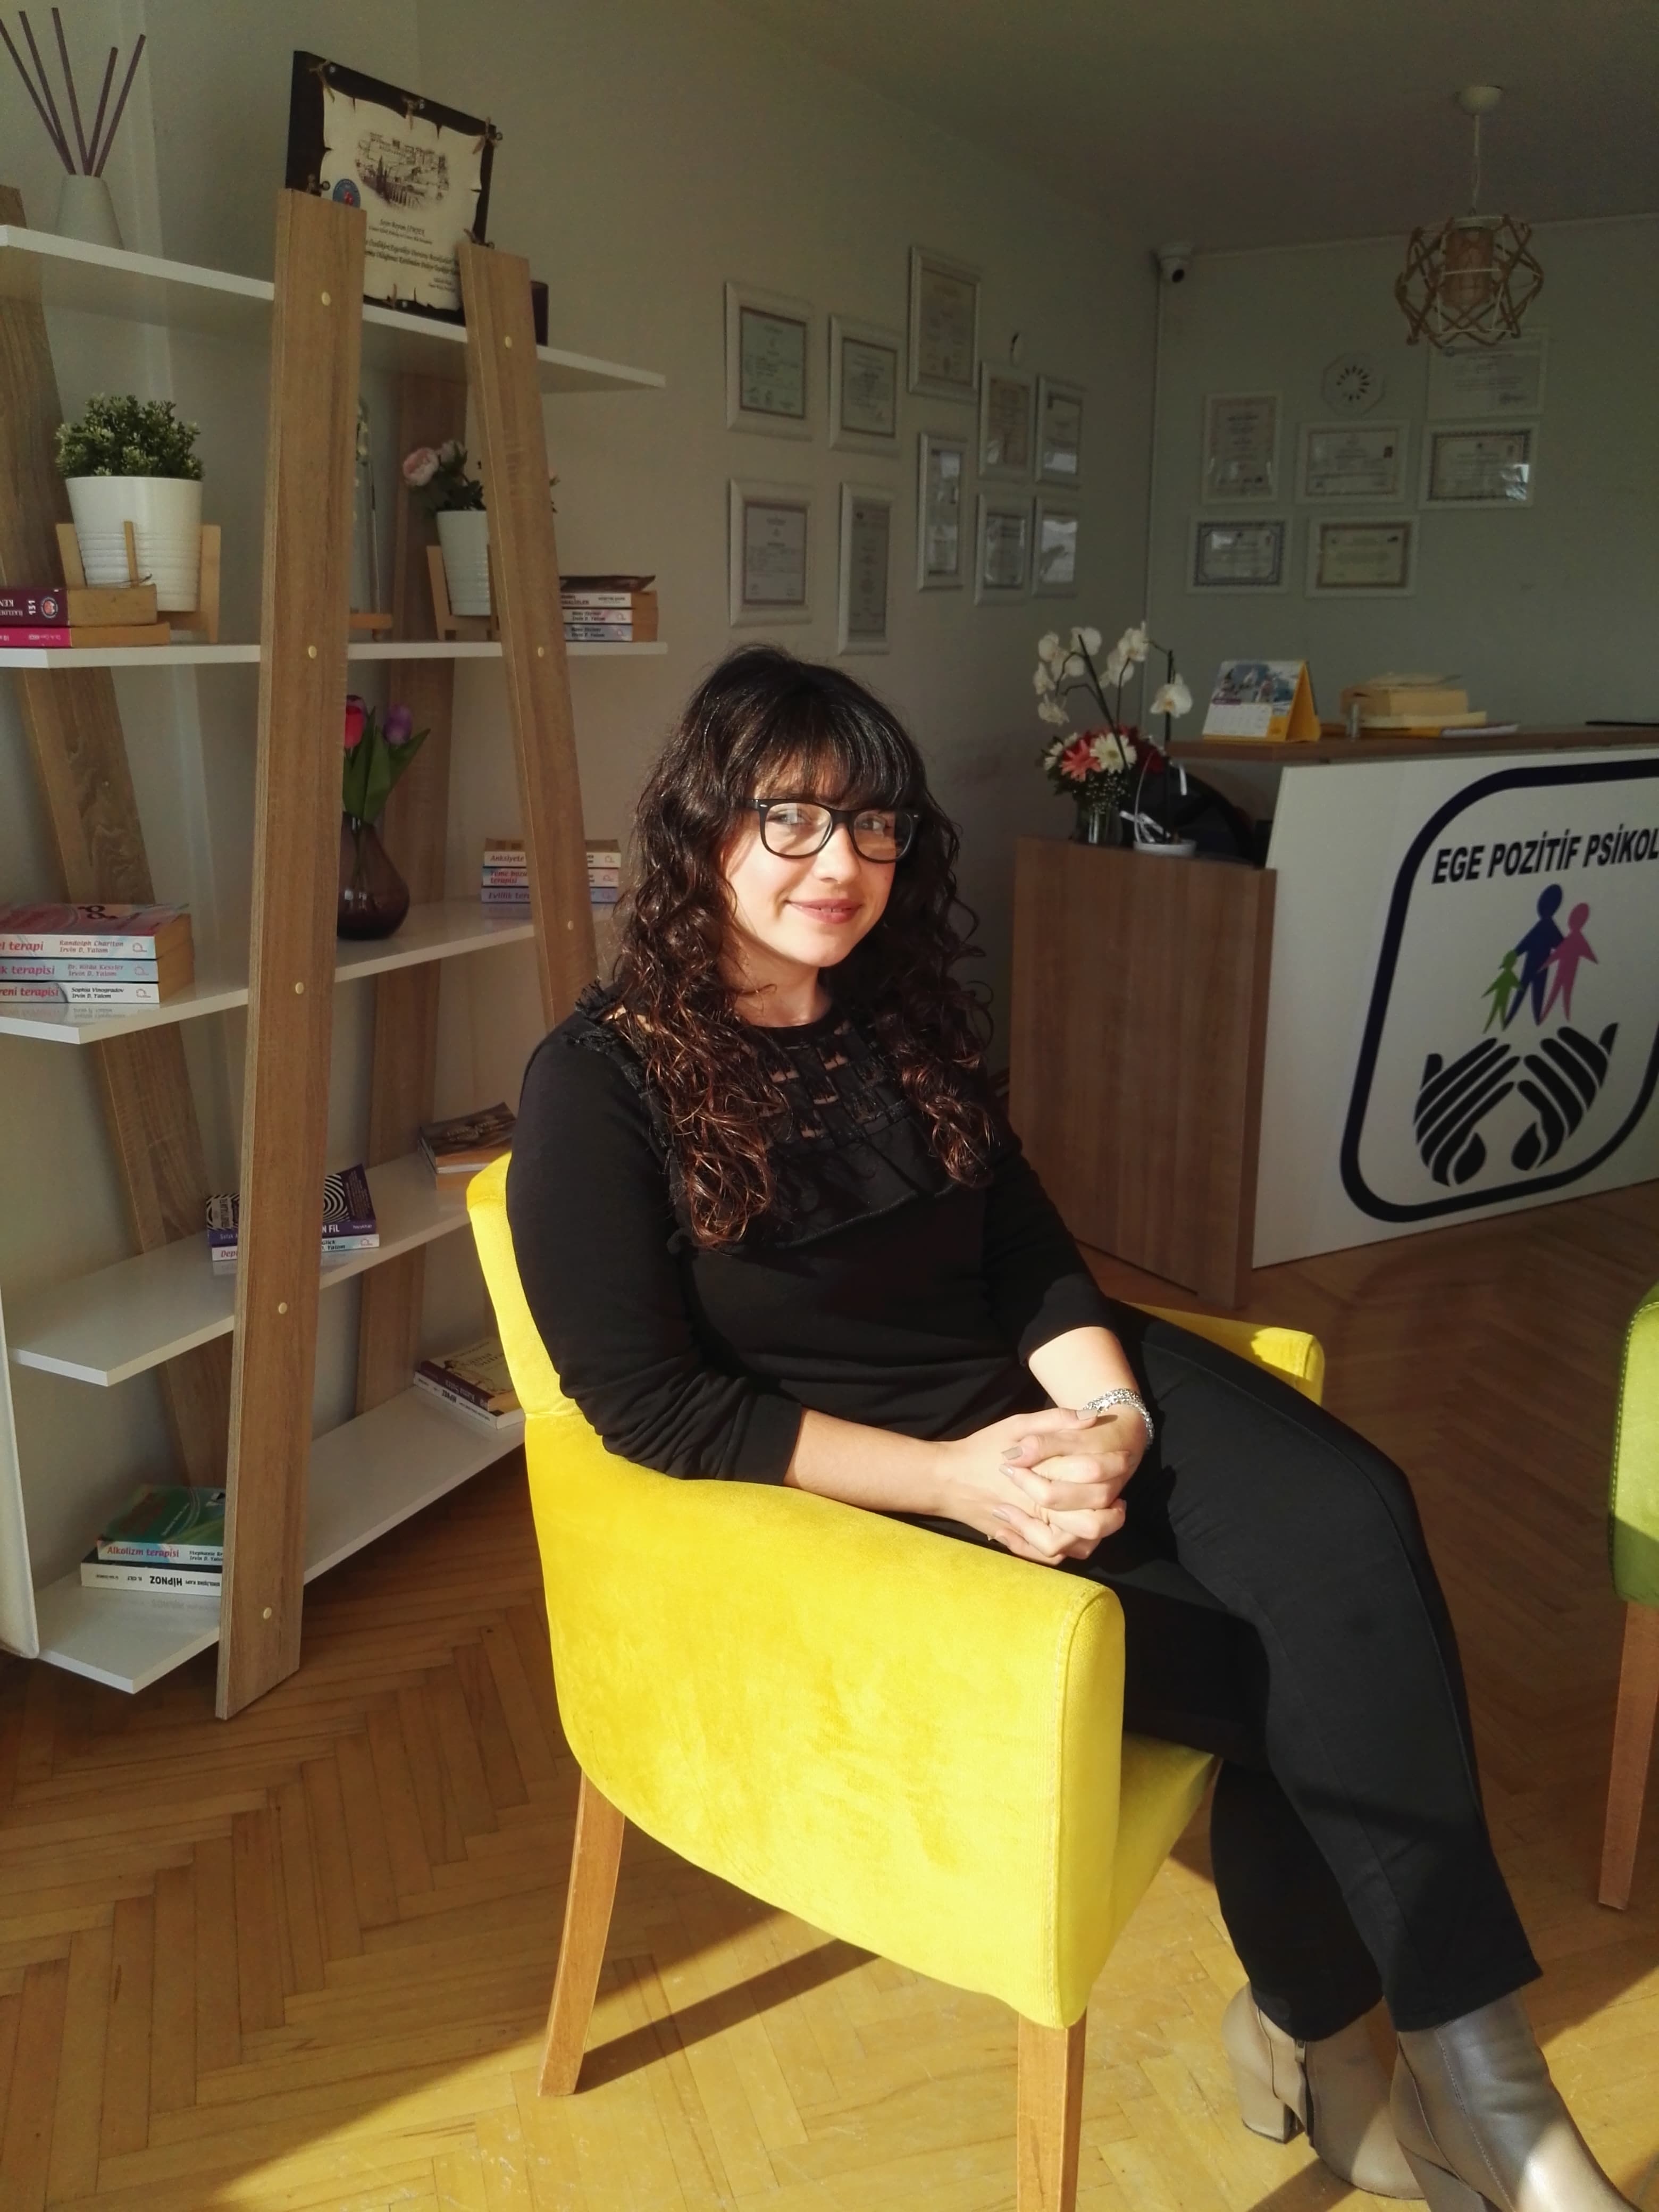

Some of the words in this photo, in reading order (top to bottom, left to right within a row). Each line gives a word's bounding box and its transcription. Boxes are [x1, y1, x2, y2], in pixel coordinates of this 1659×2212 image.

[1431, 845, 1485, 884] EGE
[1487, 829, 1583, 878] POZİTİF
[1582, 823, 1658, 868] PSİKOL
[9, 941, 44, 952] terapi
[12, 965, 55, 976] terapisi
[21, 987, 58, 998] terapisi
[107, 1546, 144, 1556] Alkolizm
[146, 1548, 179, 1559] terapisi
[149, 1575, 182, 1587] HİPNOZ
